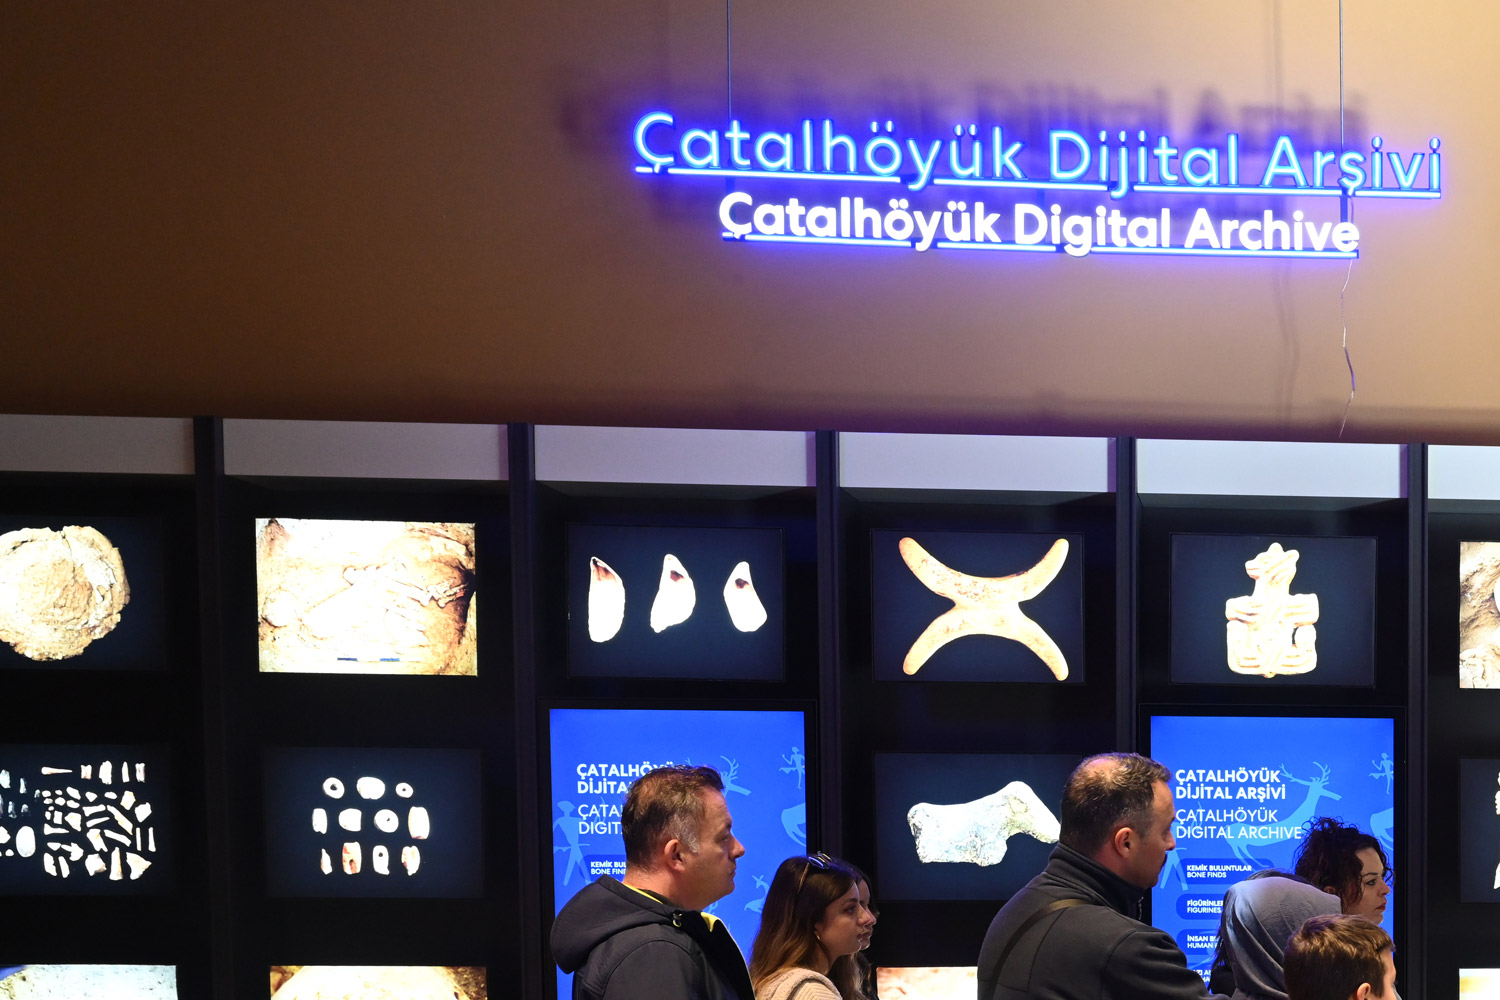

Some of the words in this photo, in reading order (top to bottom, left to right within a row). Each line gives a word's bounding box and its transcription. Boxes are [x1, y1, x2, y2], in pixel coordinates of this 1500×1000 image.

[633, 110, 1028, 191] Çatalhöyük
[1048, 129, 1240, 199] Dijital
[1259, 135, 1442, 196] Arşivi
[718, 191, 1002, 252] Çatalhöyük
[1014, 203, 1171, 257] Digital
[1184, 207, 1361, 252] Archive
[576, 761, 674, 780] ÇATALHÖ
[1175, 767, 1281, 785] ÇATALHÖYÜK
[577, 778, 632, 794] DİJİTA
[1175, 783, 1233, 799] DİJİTAL
[1235, 784, 1286, 803] ARŞİVİ
[1175, 806, 1278, 825] ÇATALHÖYÜK
[578, 821, 623, 835] DIGIT
[1176, 826, 1235, 839] DIGITAL
[1238, 826, 1302, 839] ARCHIVE
[1187, 863, 1208, 871] KEMİK
